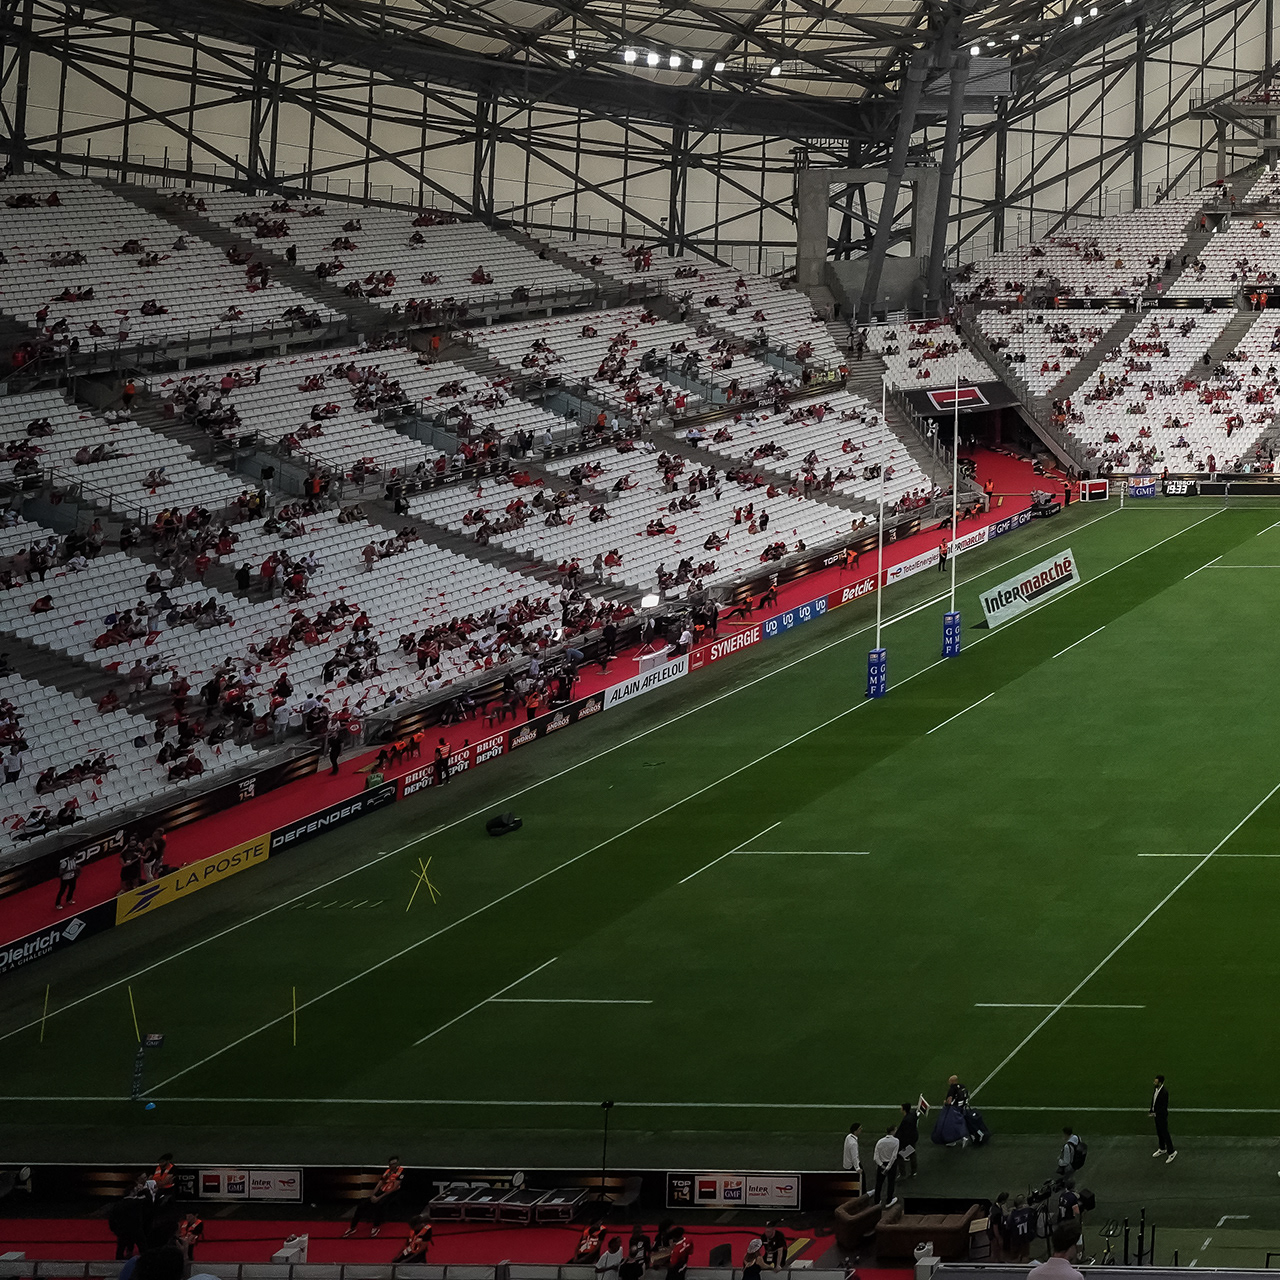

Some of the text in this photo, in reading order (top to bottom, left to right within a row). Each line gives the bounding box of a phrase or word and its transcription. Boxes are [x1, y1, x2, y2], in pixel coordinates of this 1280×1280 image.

[1136, 487, 1154, 495] GMF
[996, 521, 1011, 534] GMF
[903, 553, 940, 575] TotalEnergies
[841, 578, 875, 602] Betclic
[710, 627, 760, 661] SYNERGIE
[945, 627, 953, 654] GMF
[610, 661, 685, 704] ALAIN AFFLELOU
[870, 666, 878, 694] GMF
[578, 702, 602, 719] ANDROS
[546, 716, 570, 733] ANDROS
[476, 735, 504, 753] BRICO
[511, 731, 537, 748] ANDROS
[447, 750, 470, 767] RICO
[476, 745, 503, 765] DEPÔT
[239, 778, 256, 788] TOP
[404, 766, 434, 785] BRICO
[404, 776, 434, 796] DEPÔT
[272, 802, 362, 848] DEFENDER
[175, 843, 265, 892] LA POSTE
[673, 1191, 690, 1201] 14
[725, 1190, 741, 1198] GMF
[749, 1185, 770, 1195] Inter
